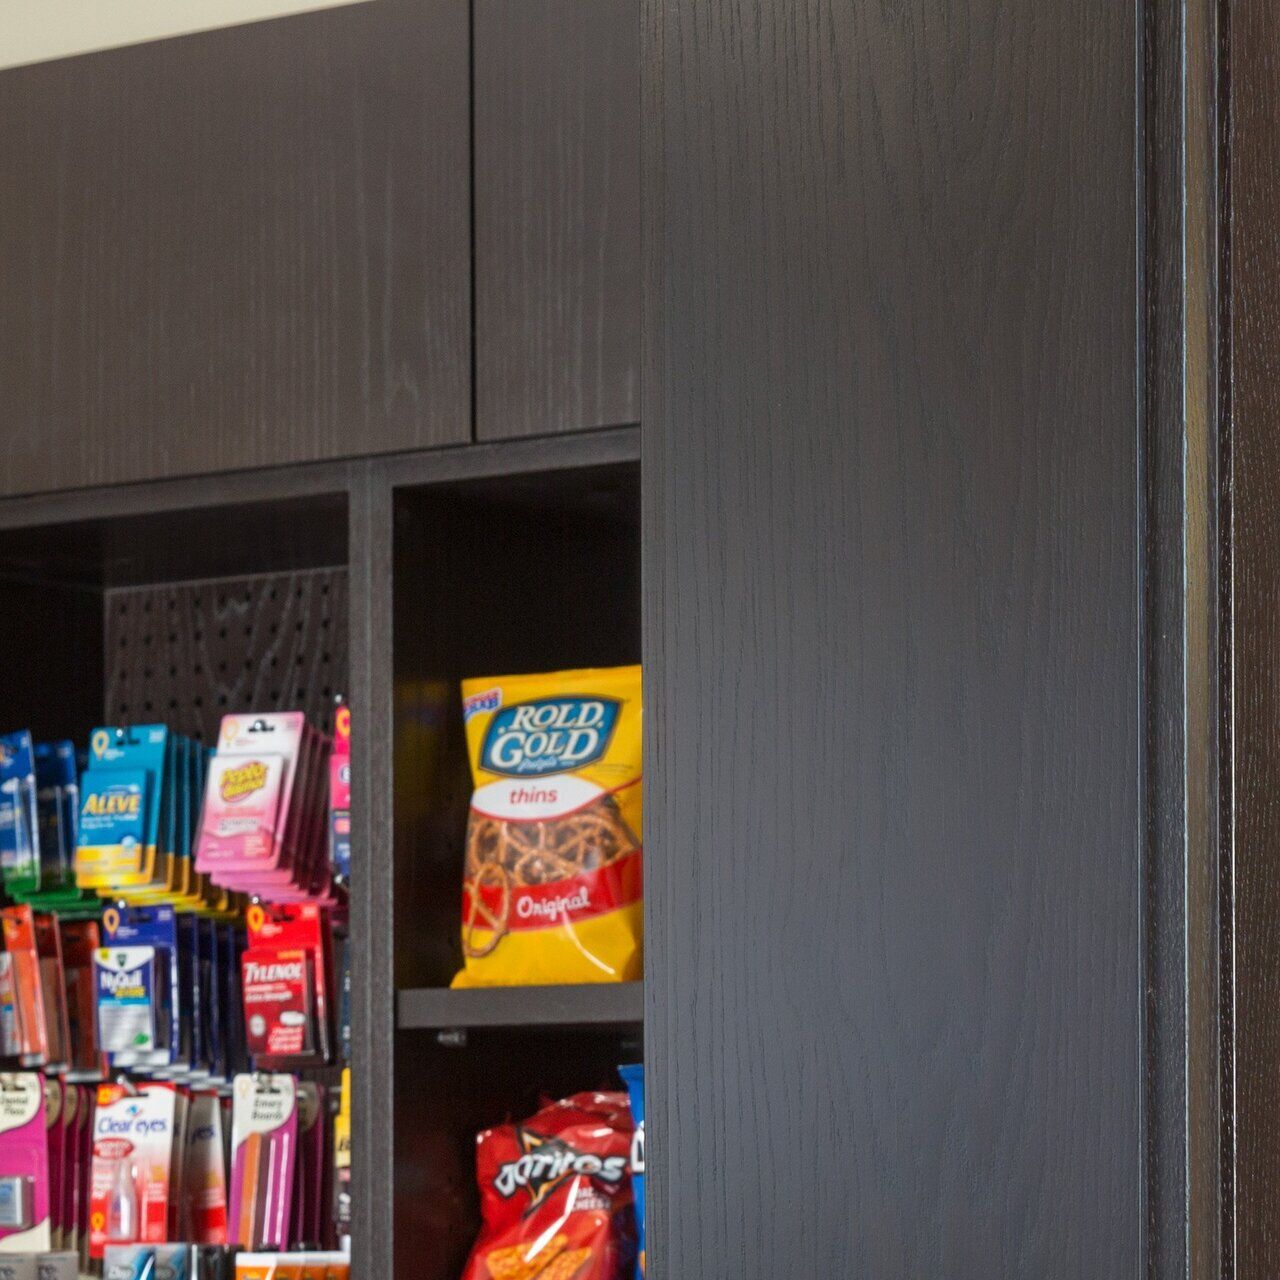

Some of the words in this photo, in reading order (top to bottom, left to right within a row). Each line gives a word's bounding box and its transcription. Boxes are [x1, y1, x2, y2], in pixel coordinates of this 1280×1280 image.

[508, 701, 605, 732] ROLD
[490, 728, 599, 768] GOLD
[82, 793, 142, 816] ALEVE
[509, 786, 557, 805] thins
[517, 886, 591, 921] Original
[244, 962, 303, 983] TYLENOL
[97, 1117, 132, 1135] Clear
[135, 1118, 168, 1136] eyes
